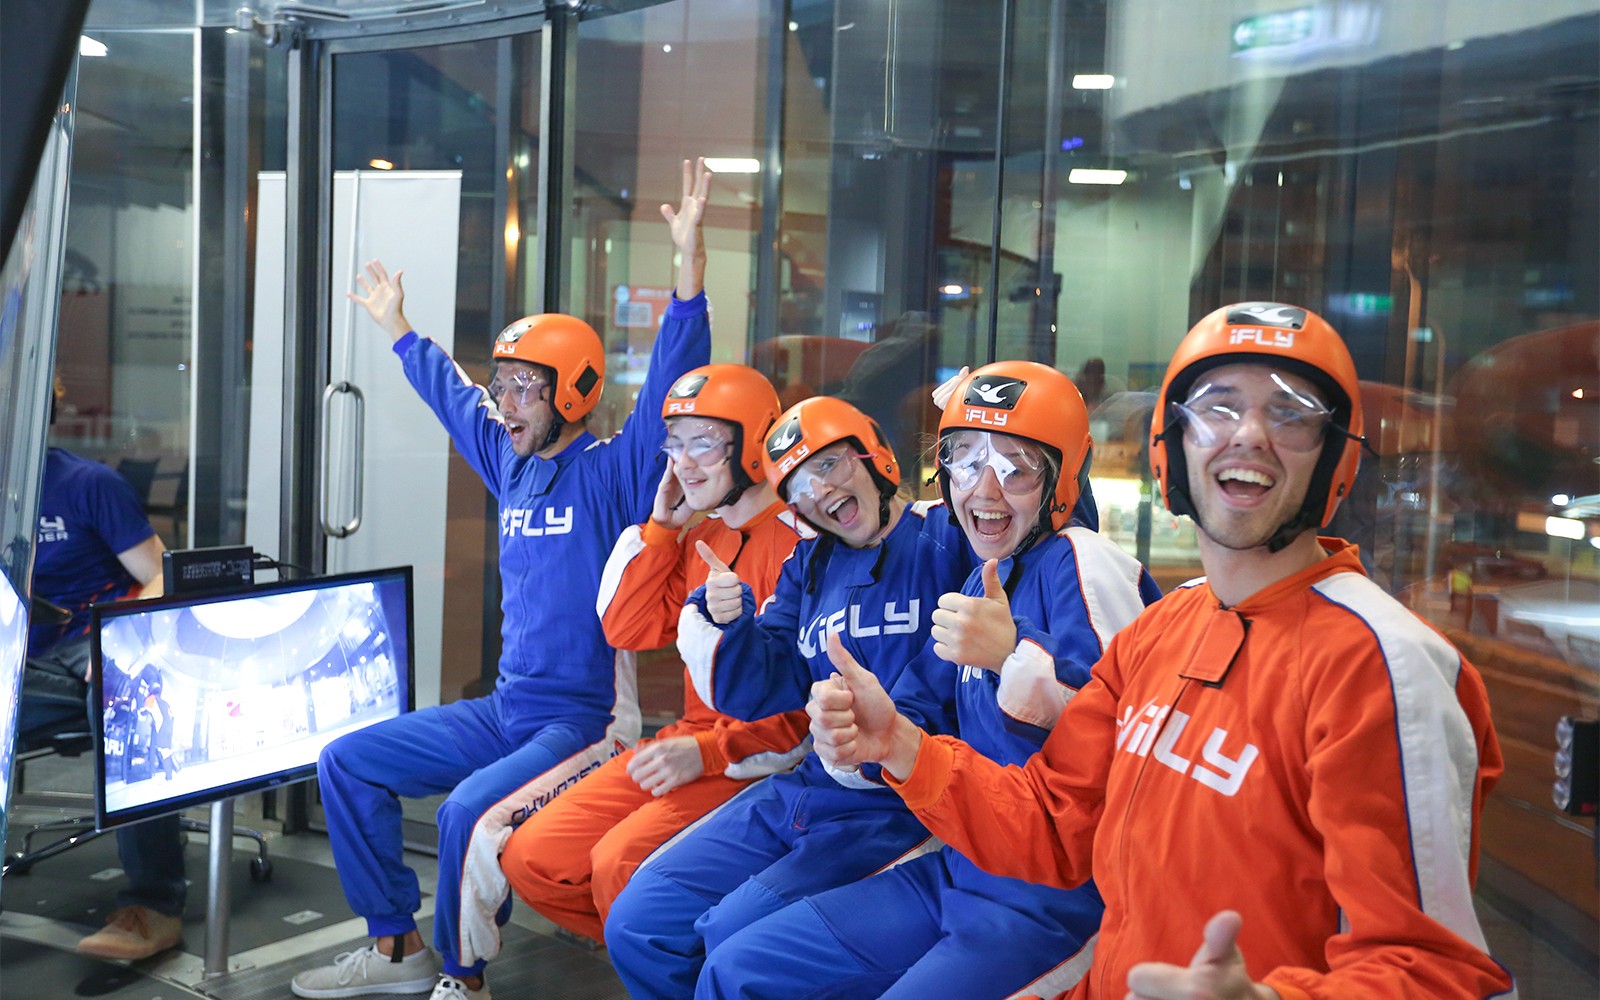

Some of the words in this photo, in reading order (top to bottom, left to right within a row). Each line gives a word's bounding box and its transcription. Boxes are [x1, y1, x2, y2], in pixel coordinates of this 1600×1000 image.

[1229, 328, 1295, 348] iFLY
[965, 408, 1008, 427] iFLY
[818, 598, 921, 655] iFLY
[1125, 703, 1260, 797] iFLY
